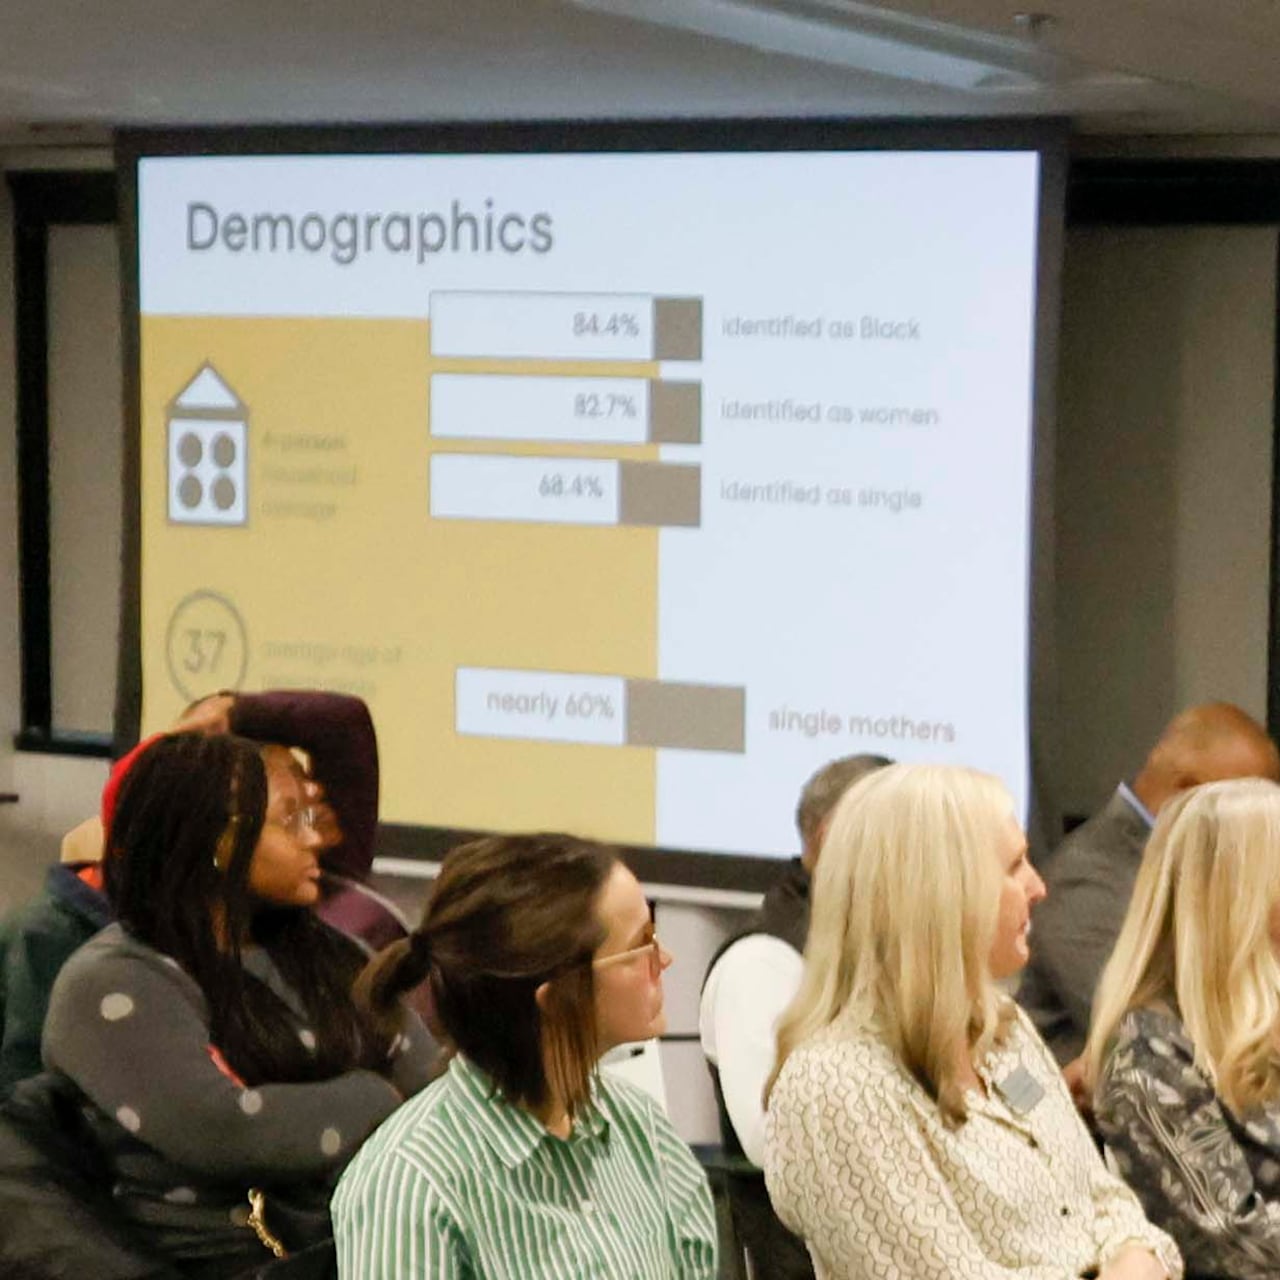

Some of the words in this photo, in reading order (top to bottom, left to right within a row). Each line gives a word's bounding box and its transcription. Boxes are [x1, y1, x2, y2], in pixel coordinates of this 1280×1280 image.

[185, 200, 554, 264] Demographics
[572, 312, 640, 338] 84.4%
[721, 315, 823, 341] identified
[827, 321, 855, 341] as
[859, 315, 921, 342] Black
[573, 393, 637, 419] 82.7%
[720, 399, 822, 425] identified
[826, 405, 855, 425] as
[858, 406, 940, 427] women
[538, 473, 604, 499] 68.4%
[720, 480, 822, 507] identified
[826, 487, 854, 508] as
[858, 486, 923, 514] single
[183, 627, 228, 675] 37
[486, 690, 558, 721] nearly
[564, 693, 616, 720] 60%
[769, 705, 842, 738] single
[848, 712, 957, 744] mothers
